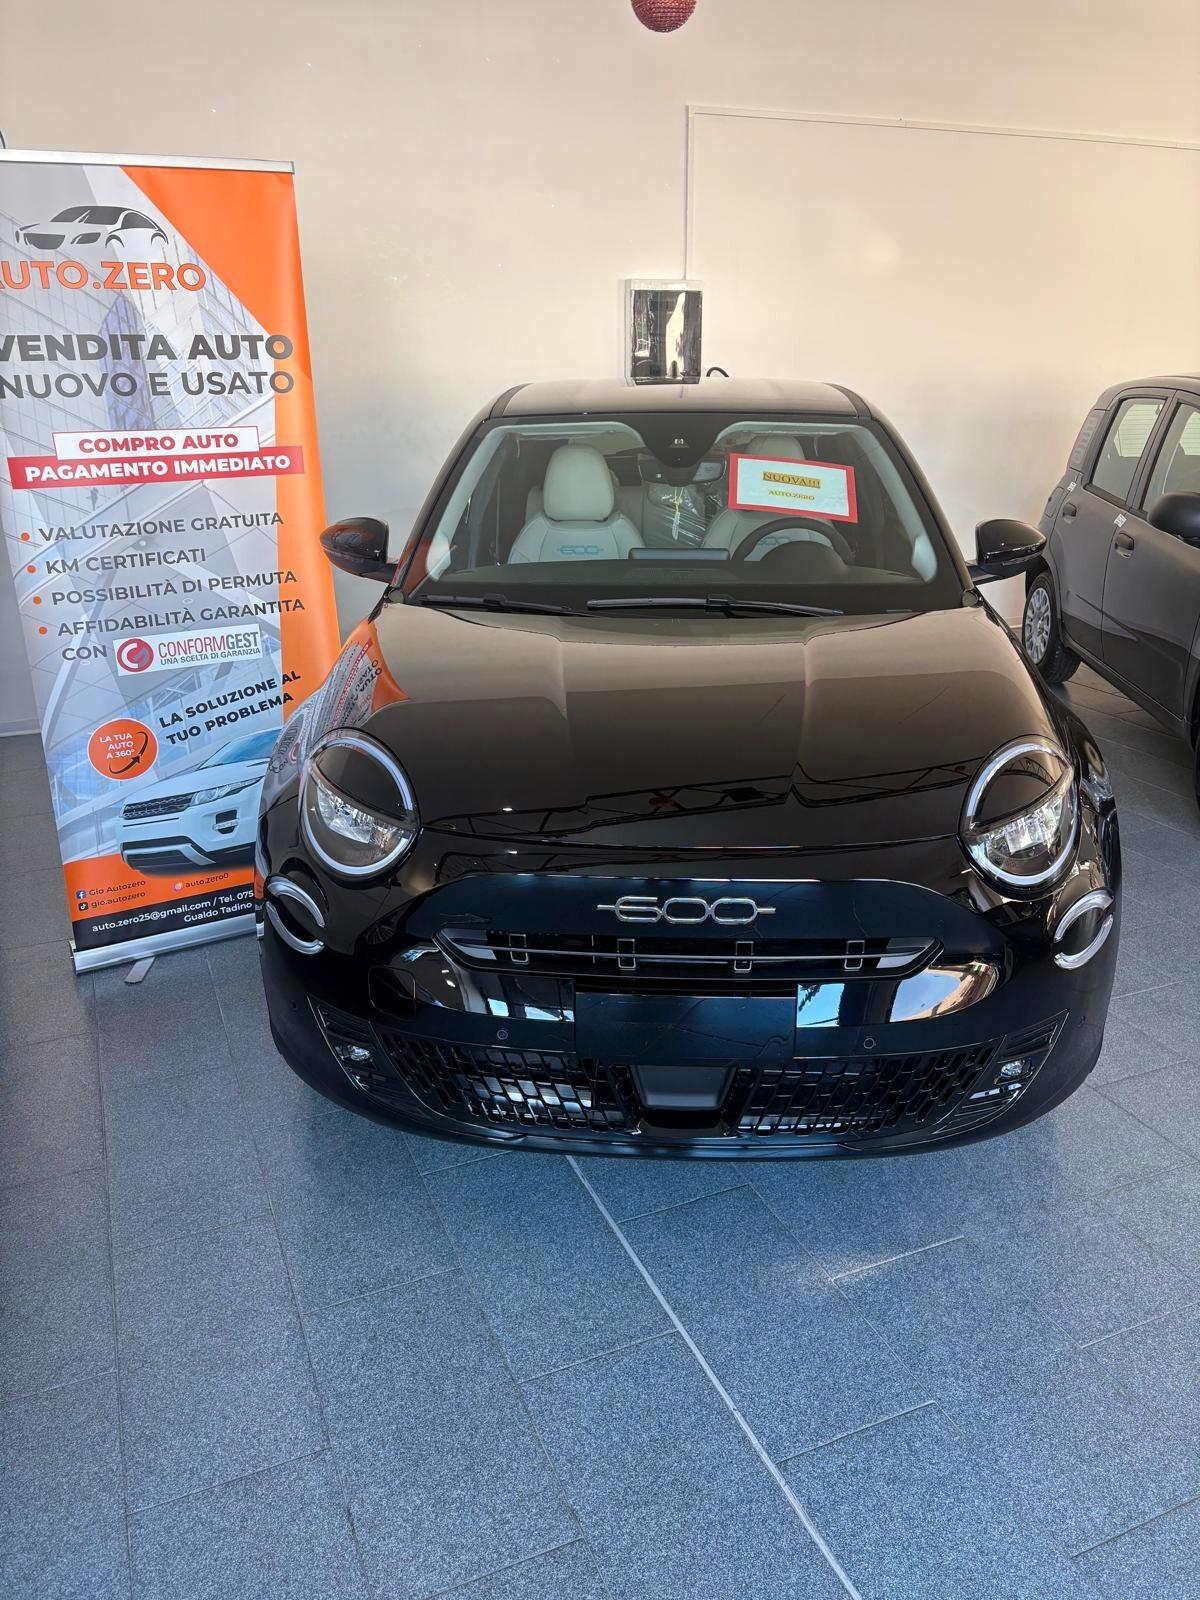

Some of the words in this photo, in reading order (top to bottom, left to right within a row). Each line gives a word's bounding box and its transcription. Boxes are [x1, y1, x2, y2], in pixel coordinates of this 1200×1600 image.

[0, 261, 207, 291] UTO.ZERO
[187, 334, 293, 361] AUTO
[0, 372, 138, 399] NUOVO
[150, 373, 171, 396] E
[181, 371, 295, 395] USATO
[78, 436, 176, 454] COMPRO
[182, 433, 239, 450] AUTO
[25, 460, 168, 482] PAGAMENTO
[174, 455, 291, 475] IMMEDIATO
[38, 519, 186, 542] VALUTAZIONE
[190, 512, 284, 531] GRATUITA
[46, 558, 79, 575] KM
[85, 548, 206, 572] CERTIFICATI
[52, 579, 178, 605] POSSIBILITÀ
[182, 579, 202, 594] DI
[208, 570, 298, 592] PERMUTA
[57, 608, 196, 637] AFFIDABILITÀ
[200, 599, 305, 622] GARANTITA
[61, 644, 108, 662] CON
[158, 631, 259, 659] CONFORMGEST
[180, 654, 209, 664] SCELTA
[210, 651, 220, 660] DI
[221, 647, 261, 659] GARANZIA
[159, 711, 184, 729] LA
[185, 678, 279, 718] SOLUZIONE
[281, 671, 302, 686] AL
[166, 725, 202, 745] TUO
[204, 692, 295, 732] PROBLEMA
[99, 735, 113, 743] LA
[113, 732, 133, 741] TUA
[108, 740, 134, 751] AUTO
[106, 752, 114, 760] A
[91, 892, 146, 908] gio.autozero
[106, 880, 146, 893] Autozero
[92, 900, 211, 932] auto.zero25@gmail.com
[219, 894, 236, 904] Tel.
[183, 911, 219, 923] Gualdo
[219, 902, 253, 914] Tadino
[597, 896, 777, 924] 600
